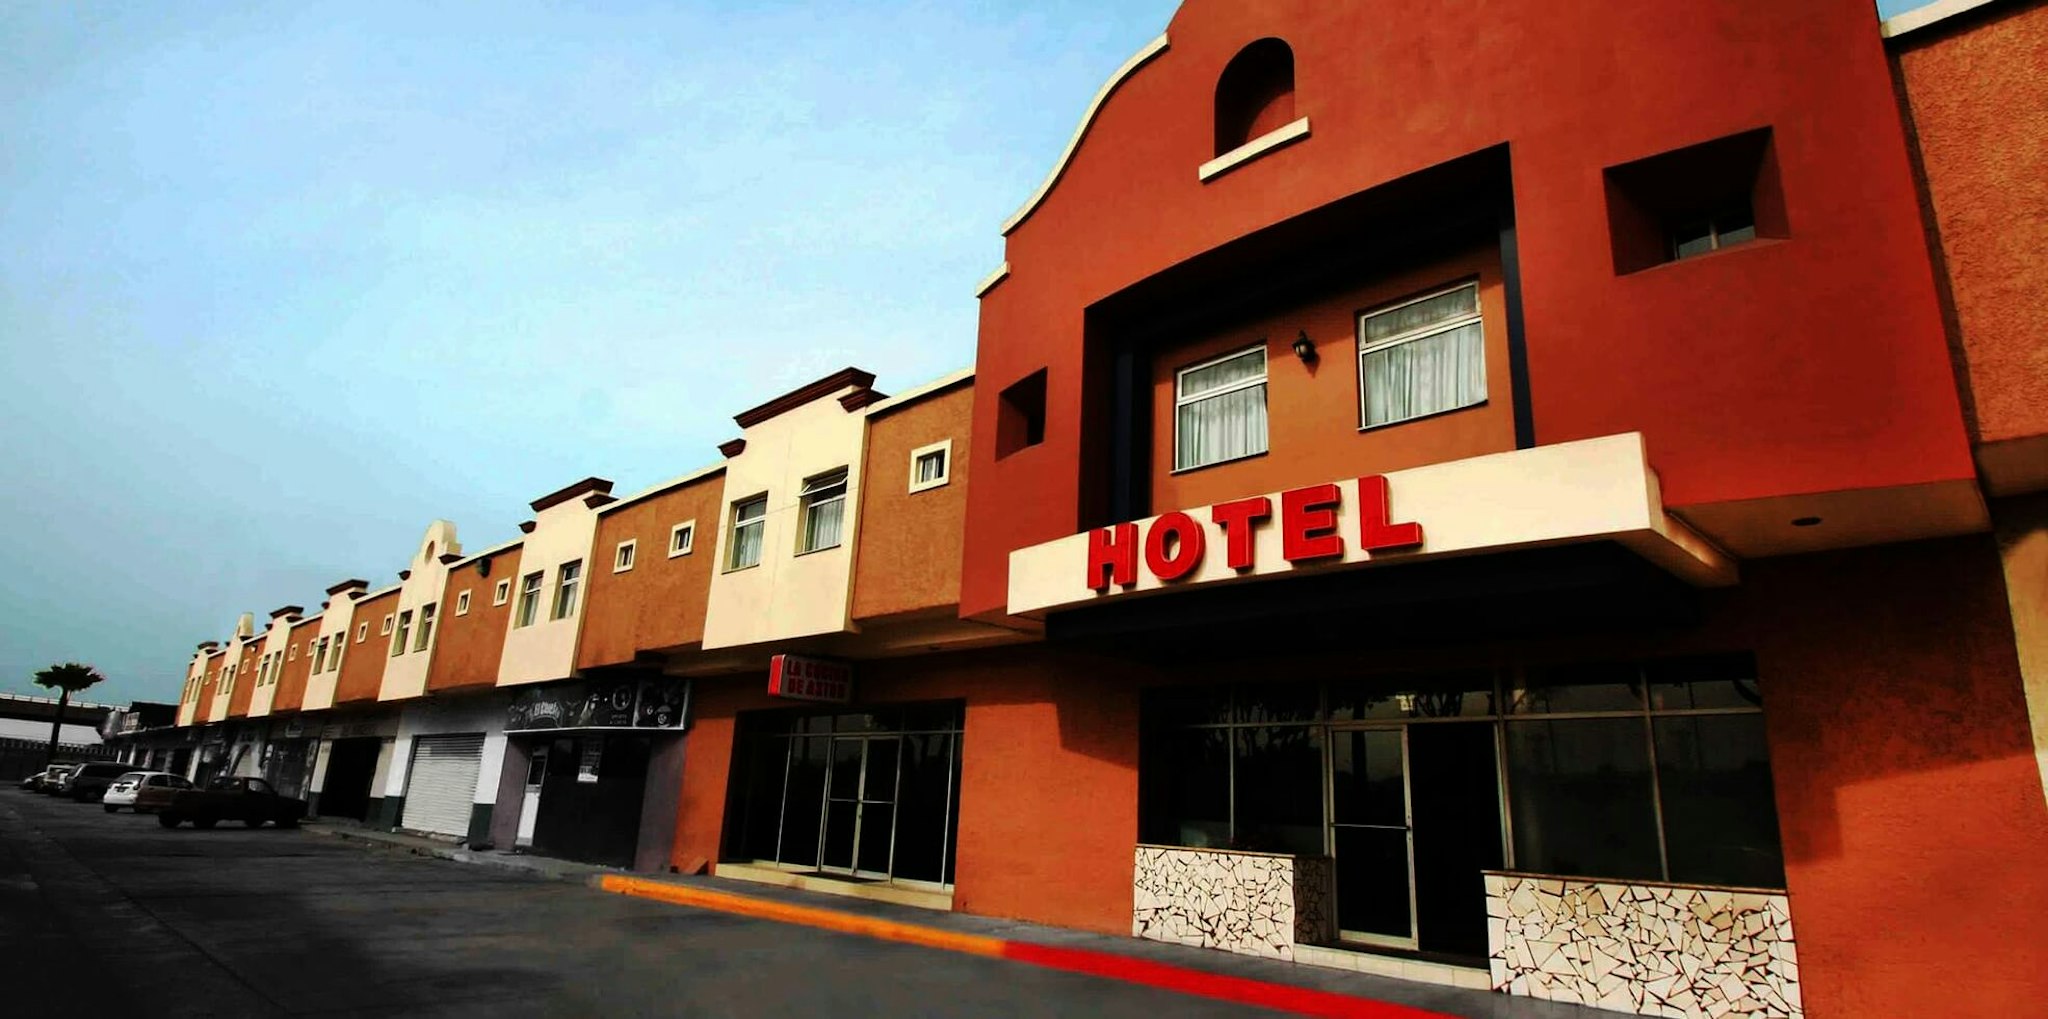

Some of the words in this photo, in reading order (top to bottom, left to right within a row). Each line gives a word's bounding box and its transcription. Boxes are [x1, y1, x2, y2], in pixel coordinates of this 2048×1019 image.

[1088, 474, 1423, 591] HOTEL
[787, 660, 801, 676] LA
[788, 678, 804, 694] DE
